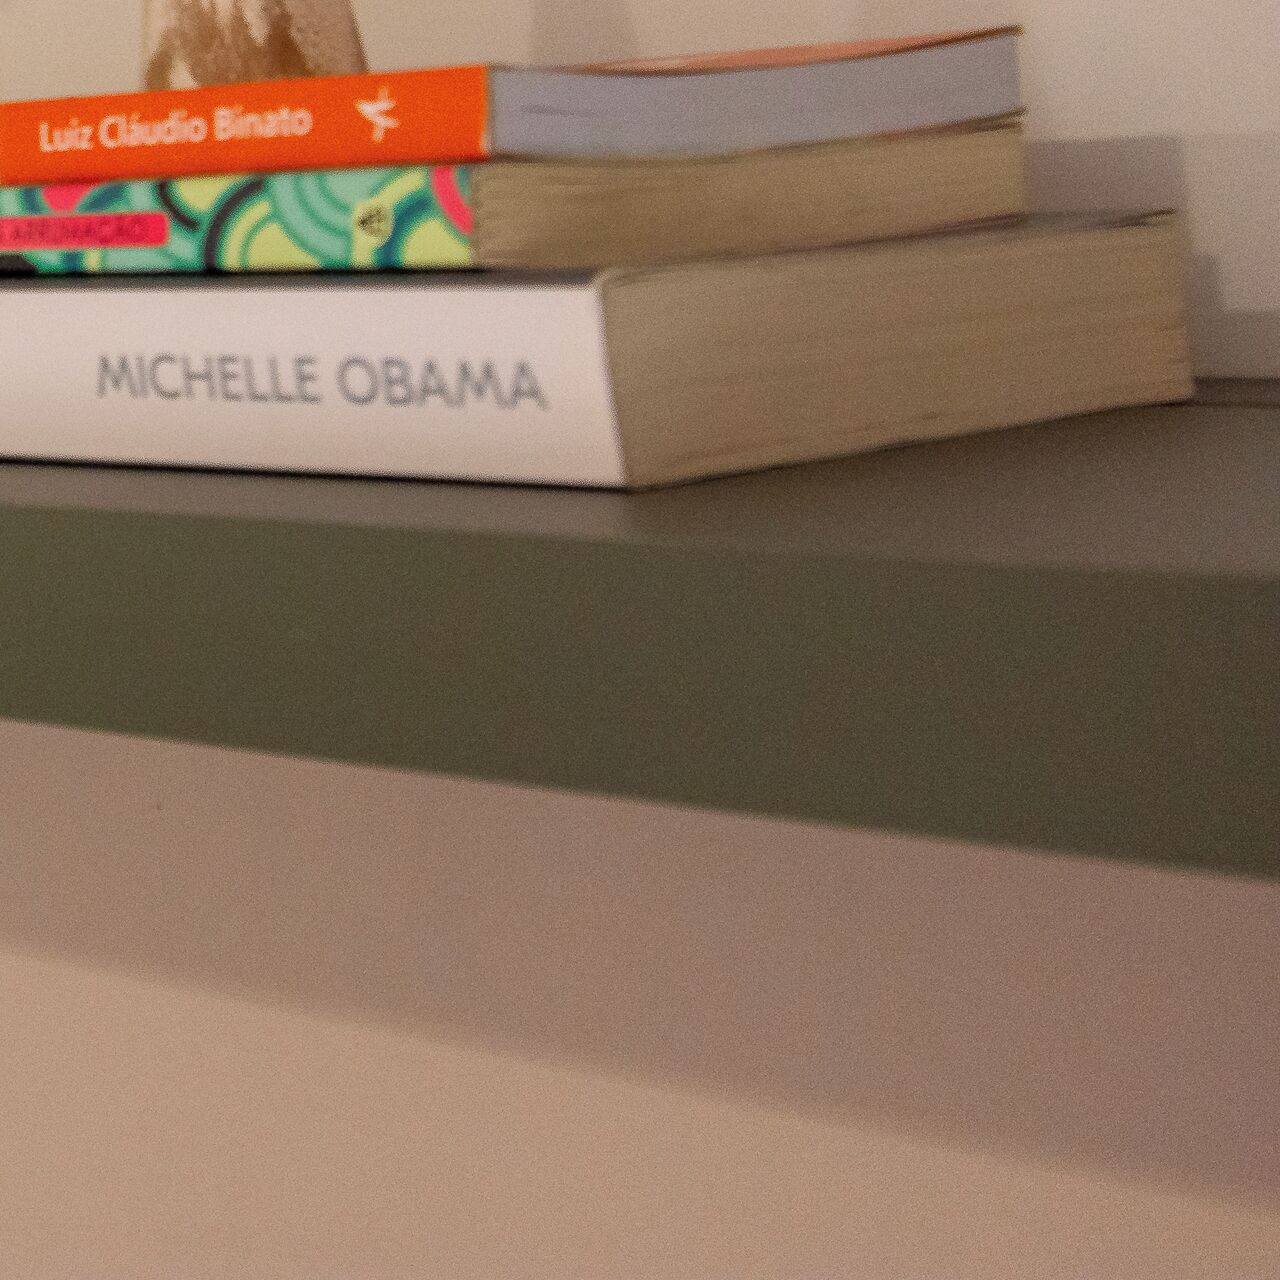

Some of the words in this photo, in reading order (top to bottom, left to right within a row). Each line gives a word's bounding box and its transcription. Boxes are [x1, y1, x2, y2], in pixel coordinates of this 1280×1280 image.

[40, 118, 92, 152] Luiz
[98, 109, 208, 149] Cláudio
[212, 105, 313, 141] Binato
[97, 353, 322, 404] MICHELLE
[338, 356, 550, 410] OBAMA
